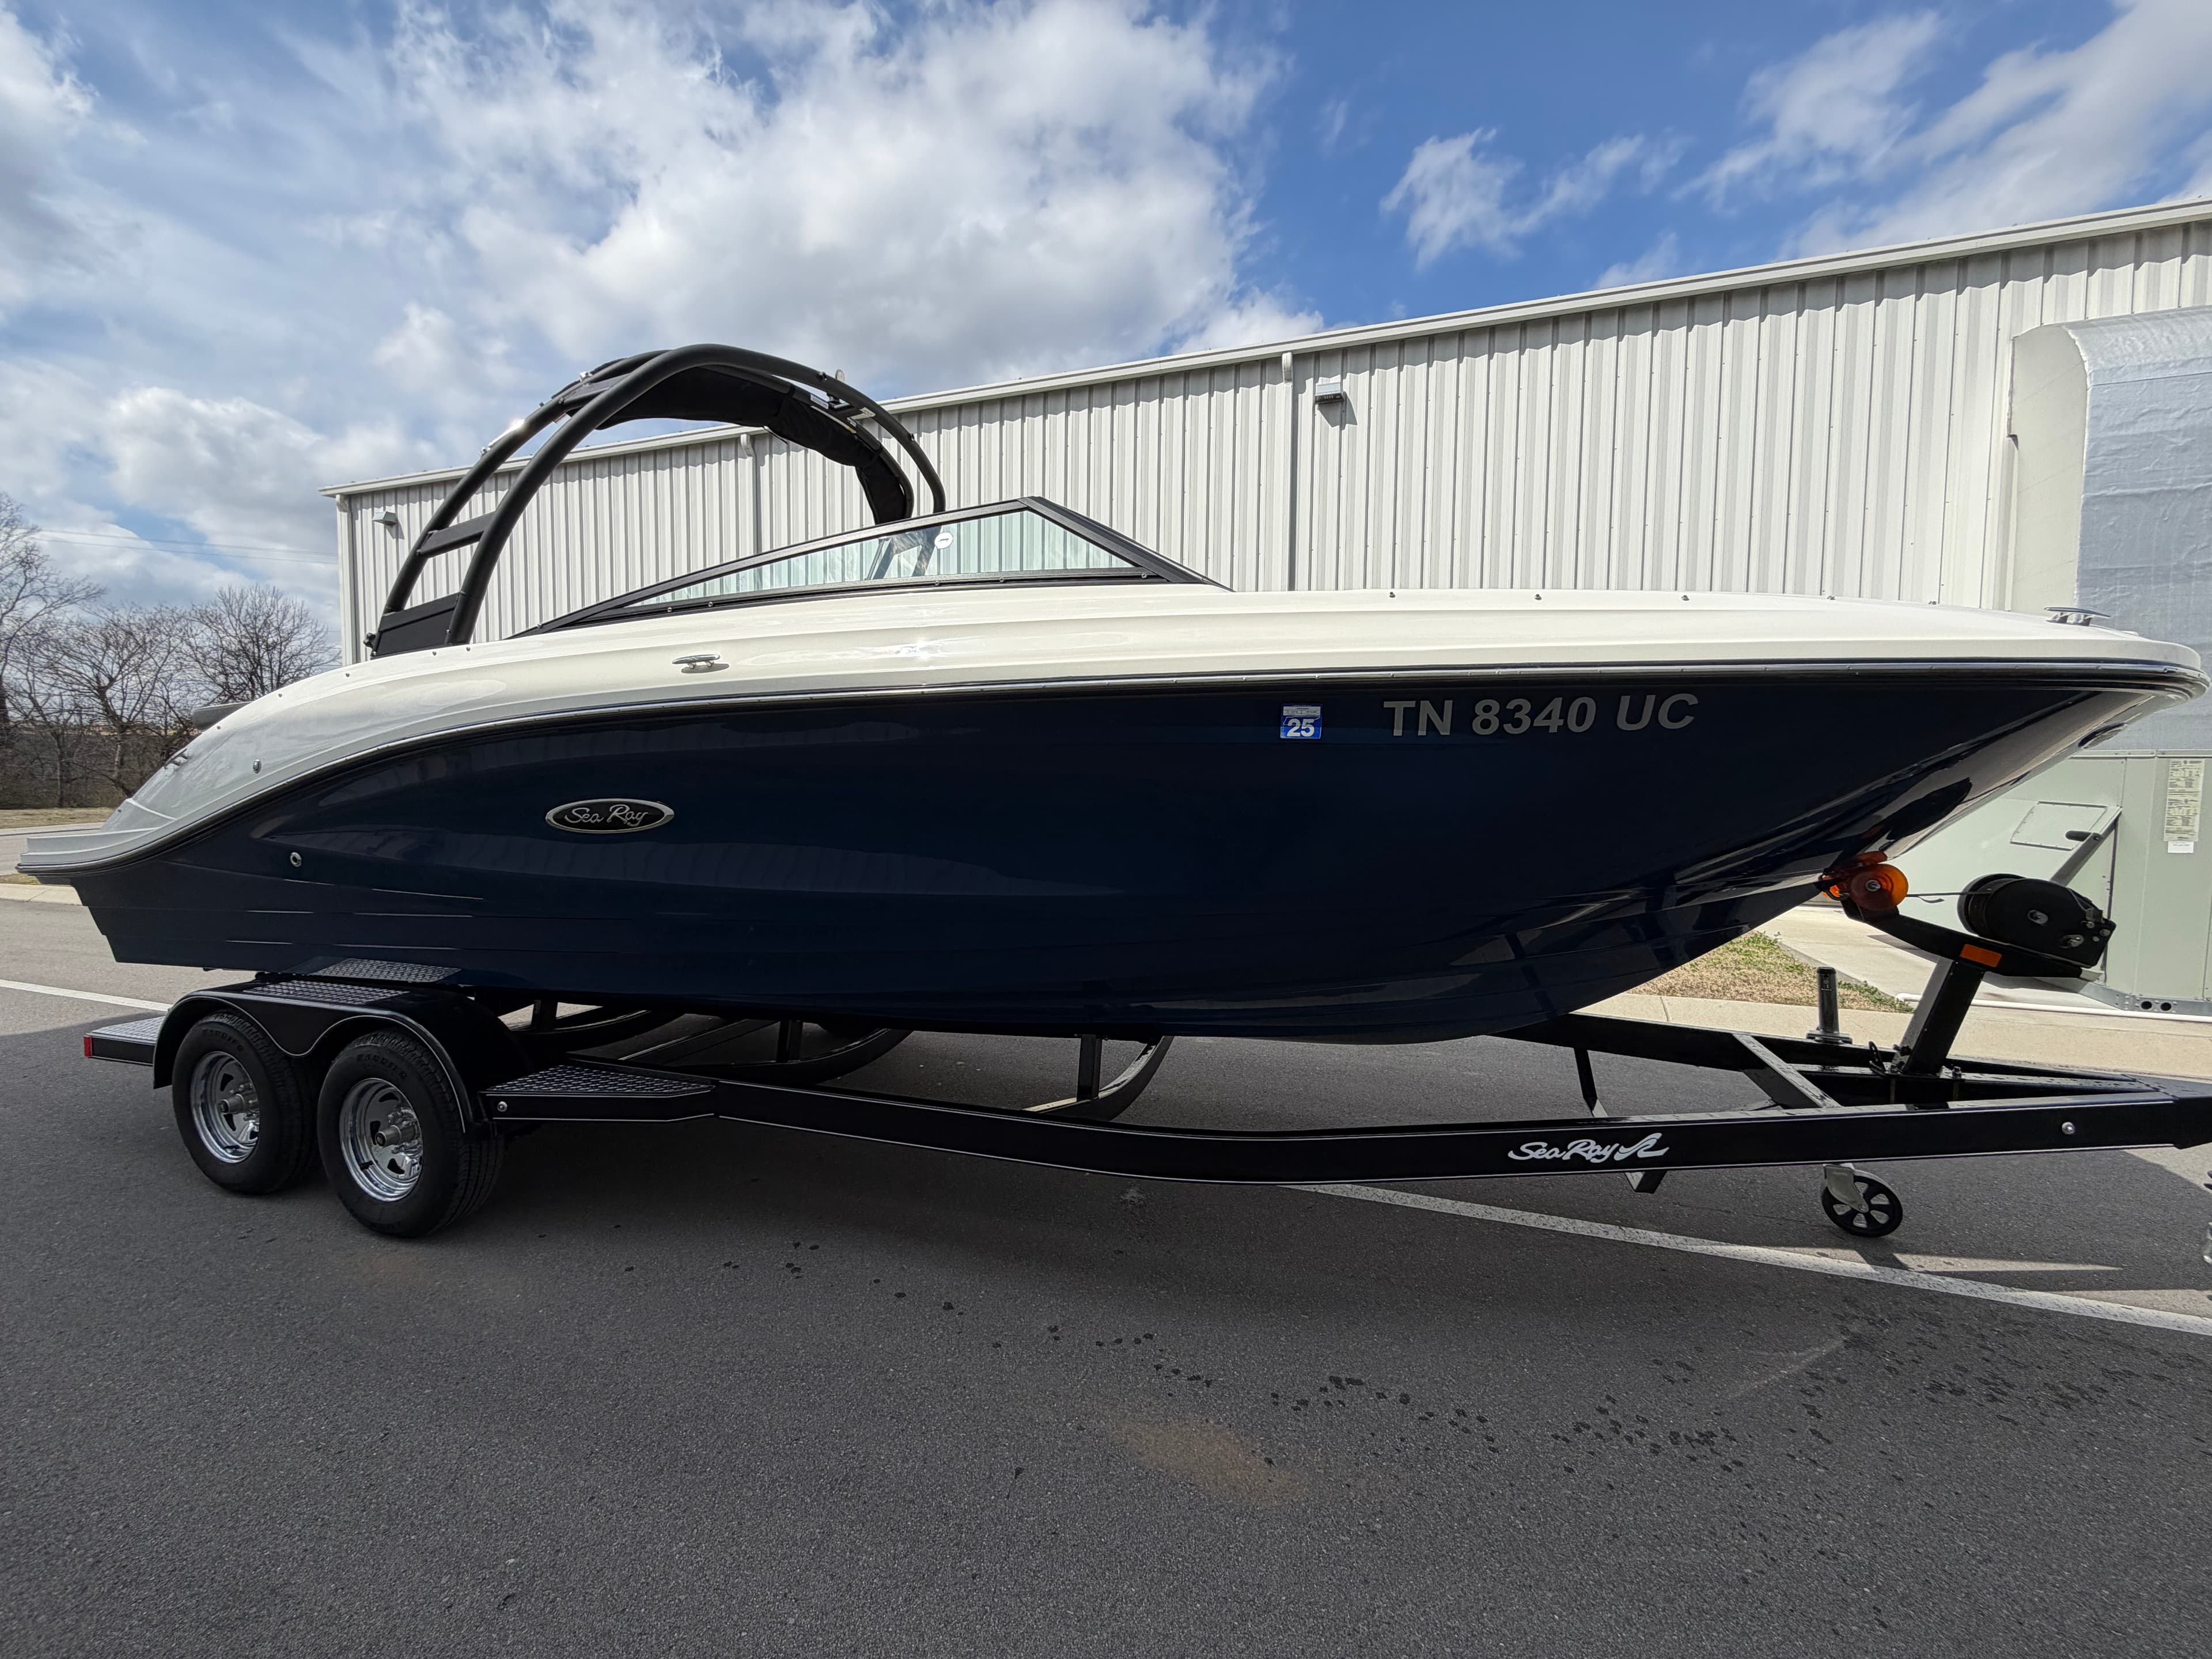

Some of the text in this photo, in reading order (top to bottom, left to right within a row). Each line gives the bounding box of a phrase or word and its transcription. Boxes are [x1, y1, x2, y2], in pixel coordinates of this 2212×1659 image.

[1384, 694, 1698, 736] TN 8340 UC
[1286, 718, 1315, 737] 25
[564, 804, 649, 827] Sea Ray
[1508, 1139, 1620, 1163] Sea Ray
